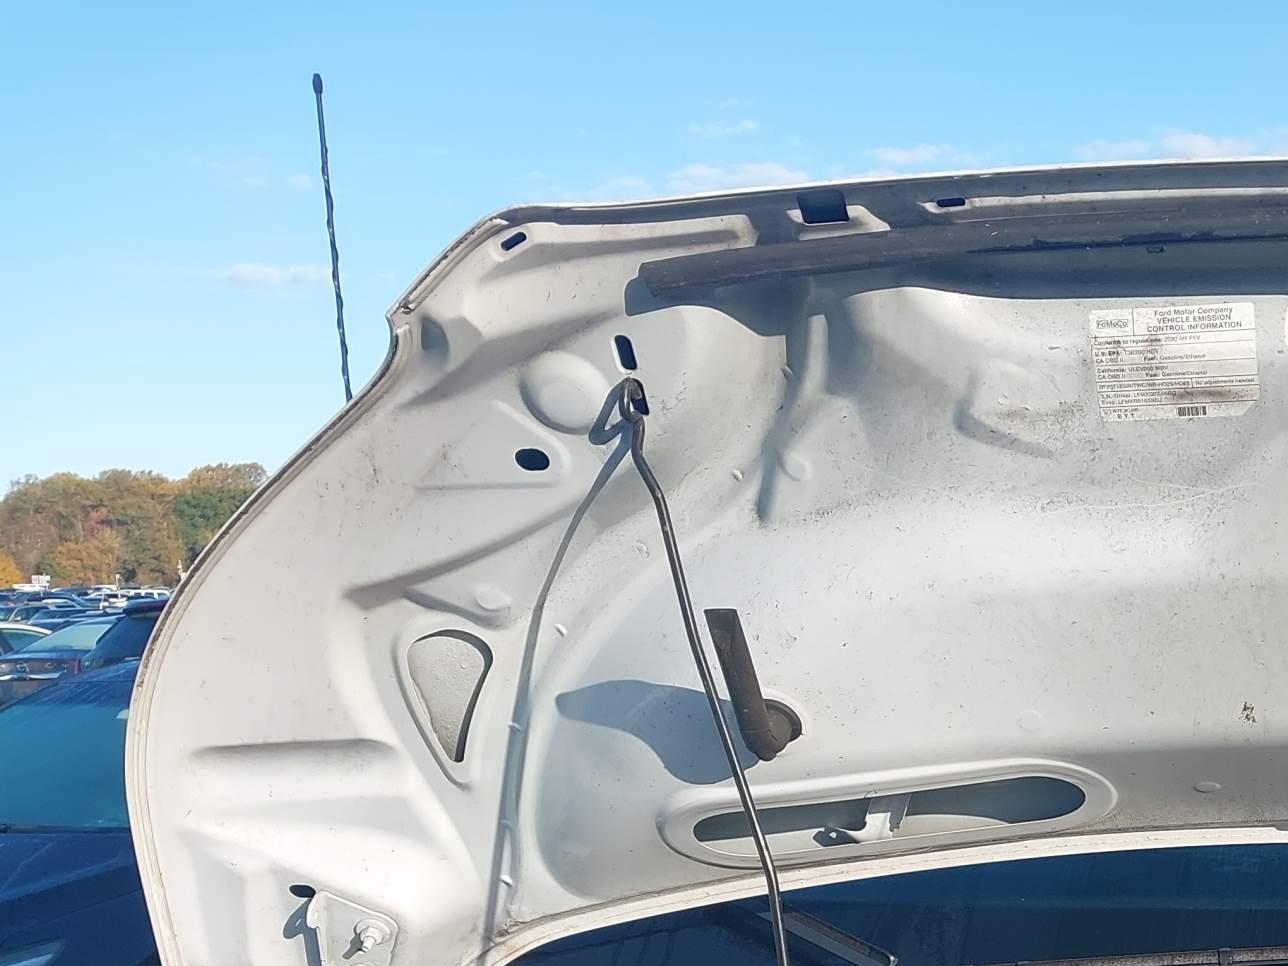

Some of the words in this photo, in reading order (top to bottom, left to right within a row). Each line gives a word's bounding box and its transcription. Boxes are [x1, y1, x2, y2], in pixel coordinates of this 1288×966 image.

[1153, 309, 1172, 317] Ford
[1173, 308, 1195, 316] Motor
[1197, 306, 1233, 315] Company
[1156, 316, 1191, 325] VEHICLE
[1193, 313, 1232, 323] EMISSION
[1146, 324, 1187, 333] CONTROL
[1187, 321, 1242, 331] INFORMATION
